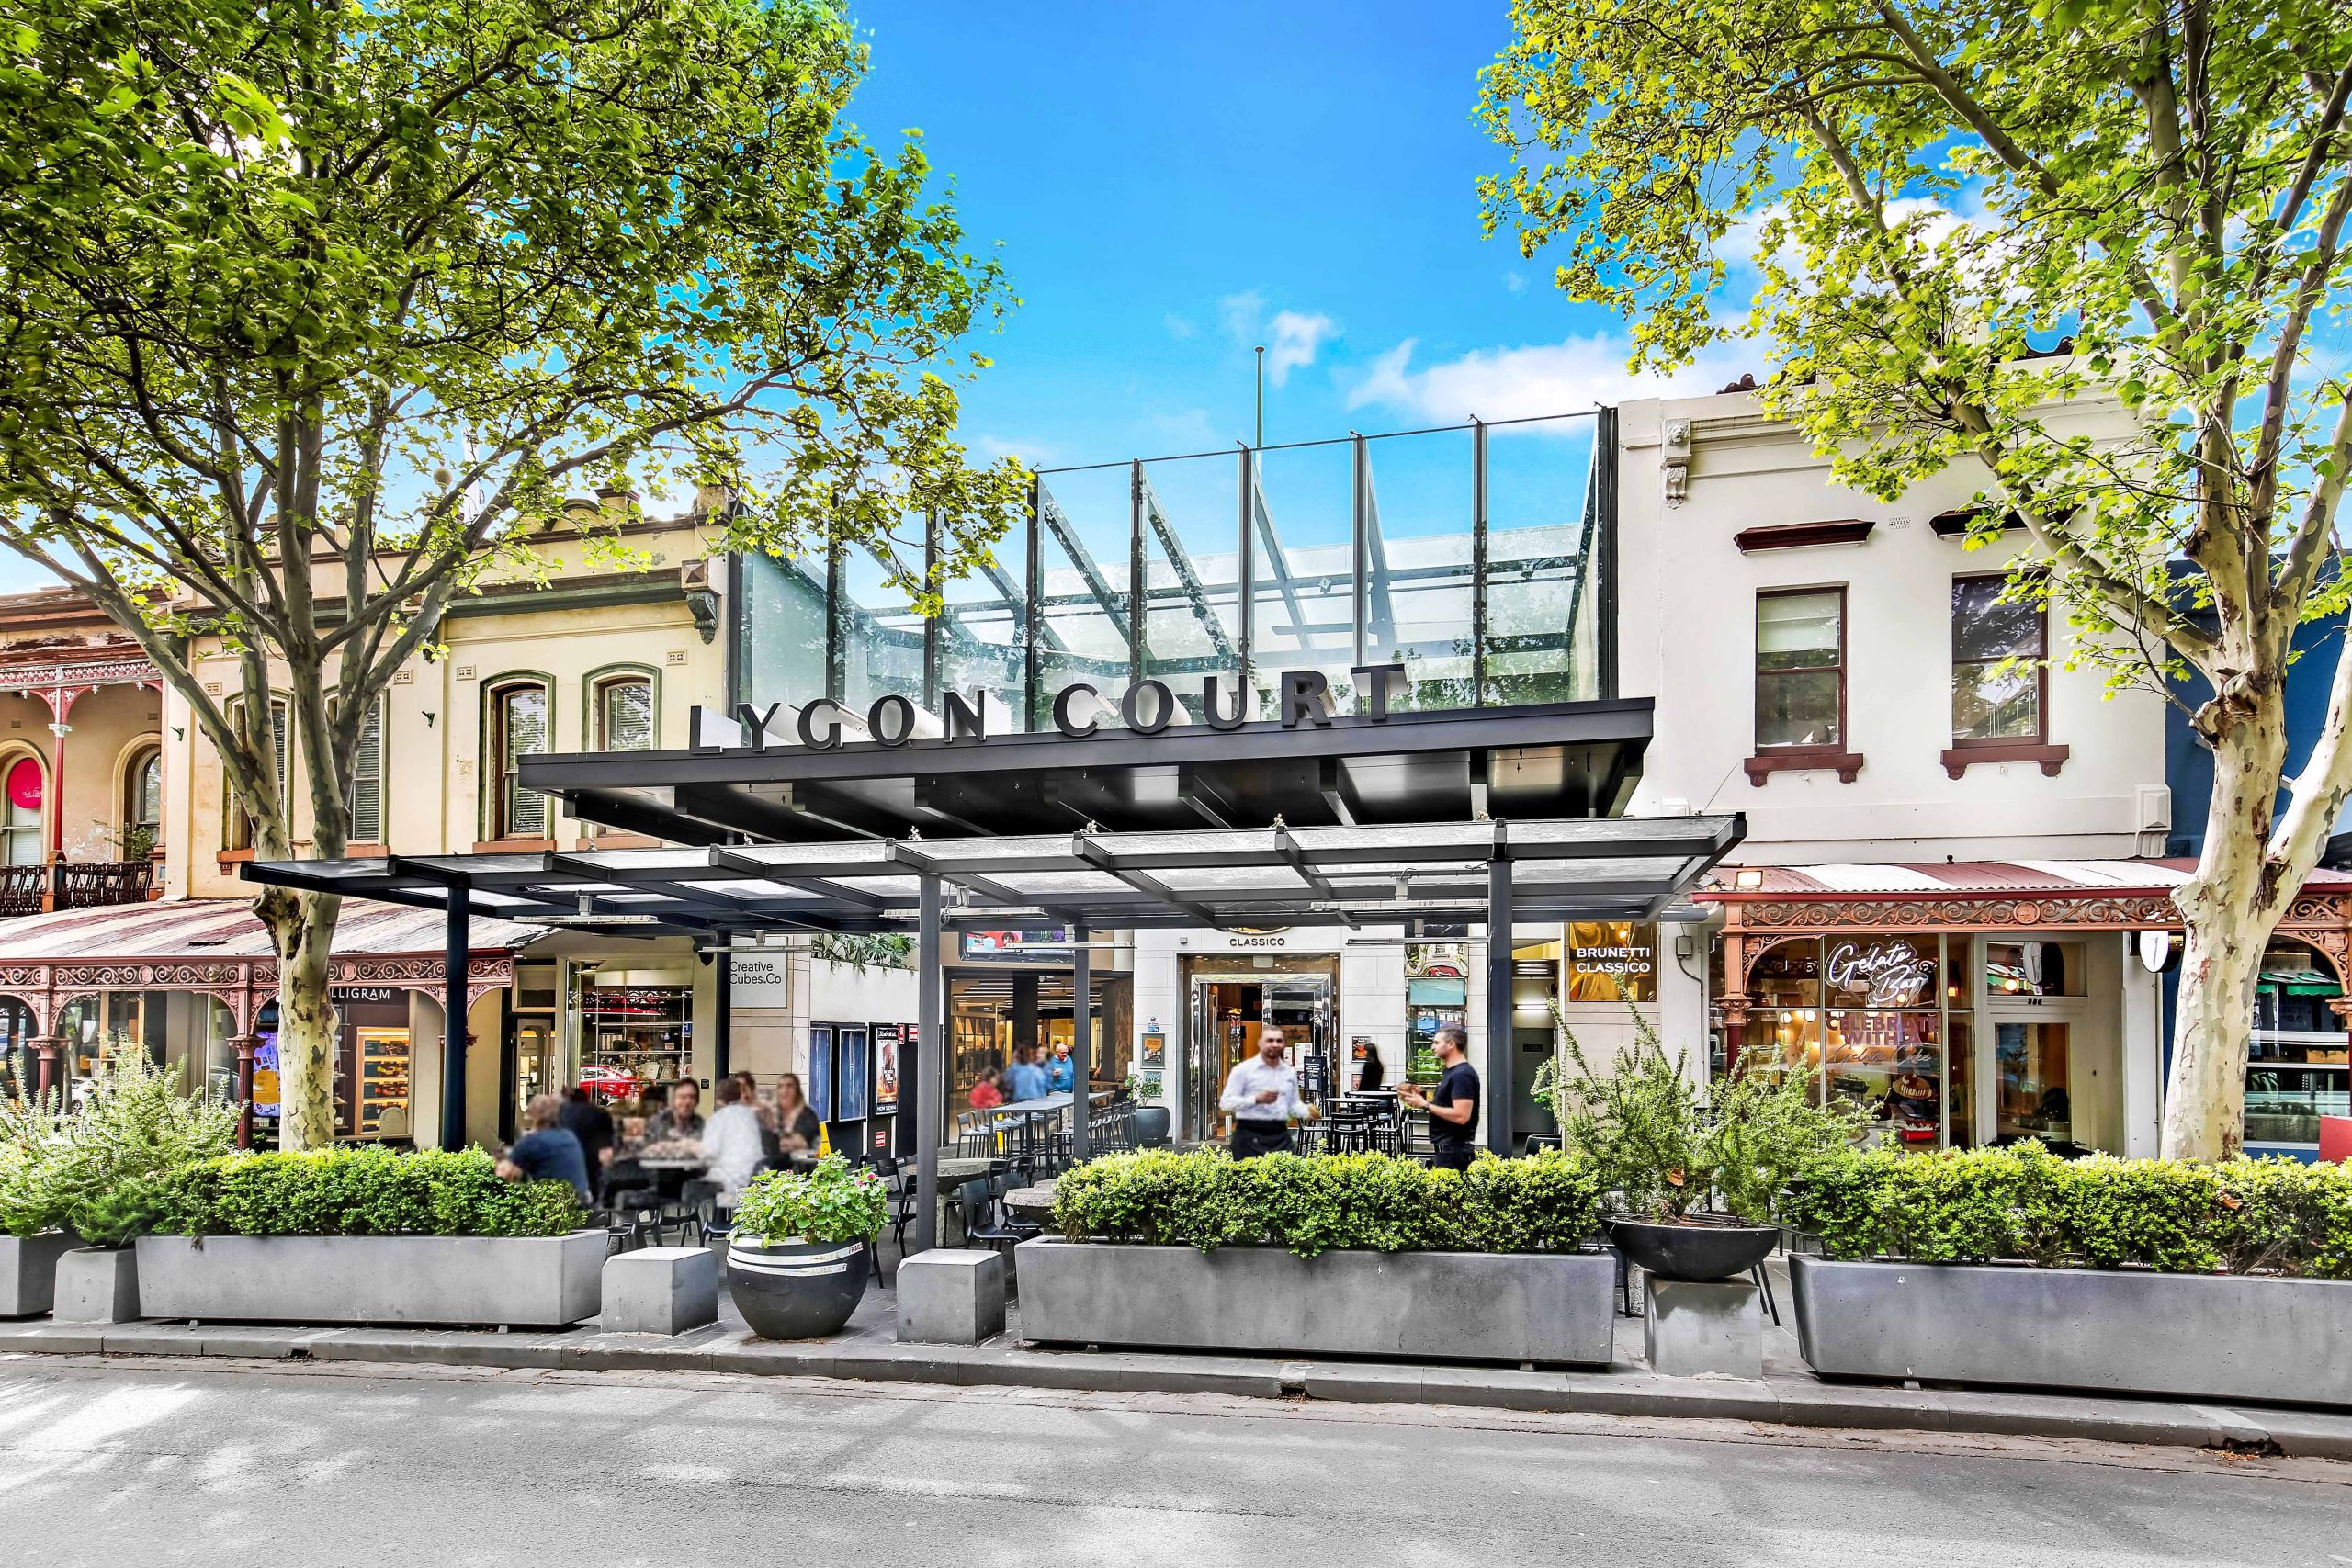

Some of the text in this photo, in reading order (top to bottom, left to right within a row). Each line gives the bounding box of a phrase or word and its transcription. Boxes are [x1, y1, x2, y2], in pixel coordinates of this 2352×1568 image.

[691, 664, 1408, 755] LYGON COURT
[1229, 937, 1285, 947] CLASSICO
[1576, 947, 1650, 958] BRUNETTI
[730, 961, 774, 972] Creative
[1576, 962, 1651, 973] CLASSICO
[1828, 944, 1912, 987] Gelato
[730, 972, 782, 985] Cubes.Co
[1872, 964, 1926, 1002] Bar
[331, 987, 390, 1001] LLIGRAM
[1826, 1016, 1940, 1032] CELEBRATE
[1841, 1031, 1898, 1046] WITH
